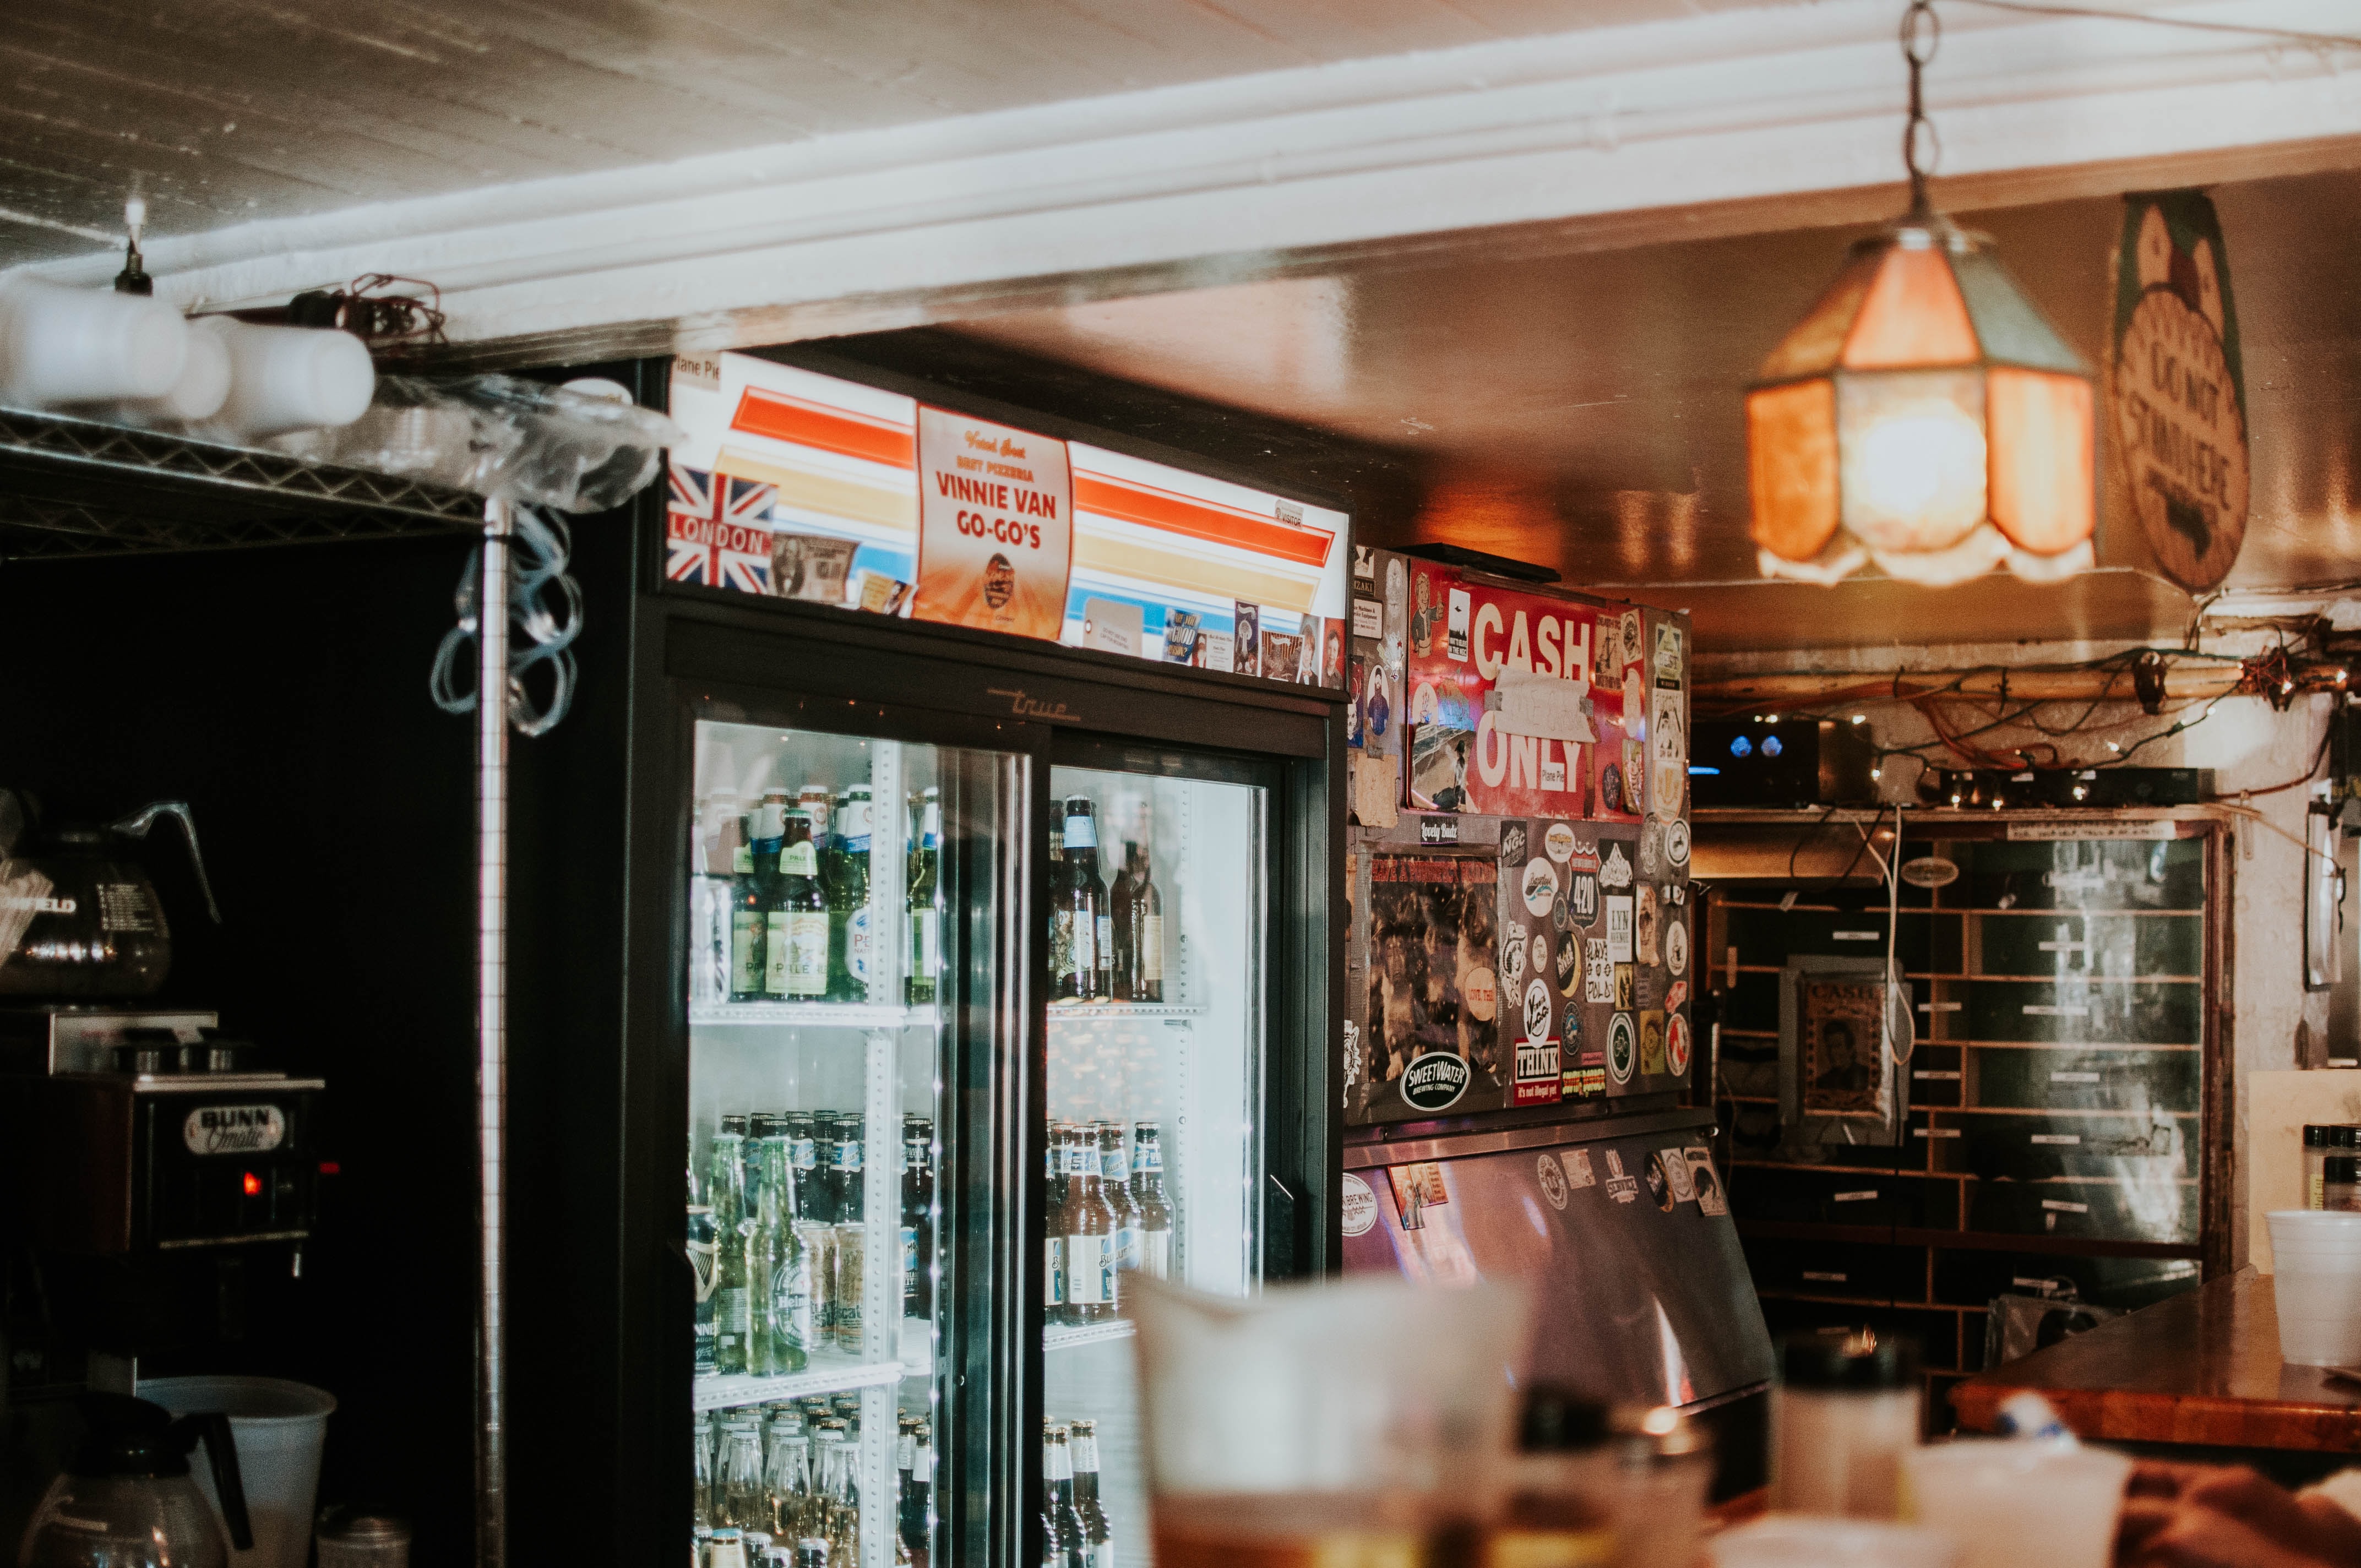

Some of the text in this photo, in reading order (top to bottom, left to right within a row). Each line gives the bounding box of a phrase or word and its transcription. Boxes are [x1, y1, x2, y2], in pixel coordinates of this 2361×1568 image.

[987, 461, 1035, 483] PIZZERIA
[936, 471, 1057, 520] VINNIE VAN
[956, 510, 1041, 549] GO-GO'S
[1282, 512, 1302, 528] VISITOR
[670, 515, 765, 552] LONDON
[1172, 626, 1195, 645] GOOD
[1474, 602, 1590, 683] CASH
[1476, 710, 1584, 793] ONLY
[1542, 769, 1555, 781] Plane
[1421, 822, 1457, 842] Lovely Budz
[1502, 832, 1525, 857] NGC
[1574, 876, 1594, 914] 420
[1611, 910, 1629, 930] LYN
[1517, 1047, 1559, 1076] THINK
[1413, 1083, 1456, 1095] BREWING COMPANY
[1526, 1086, 1534, 1097] not
[1535, 1085, 1549, 1098] illegal
[201, 1110, 270, 1128] BUNN
[1347, 1192, 1373, 1206] BREWING
